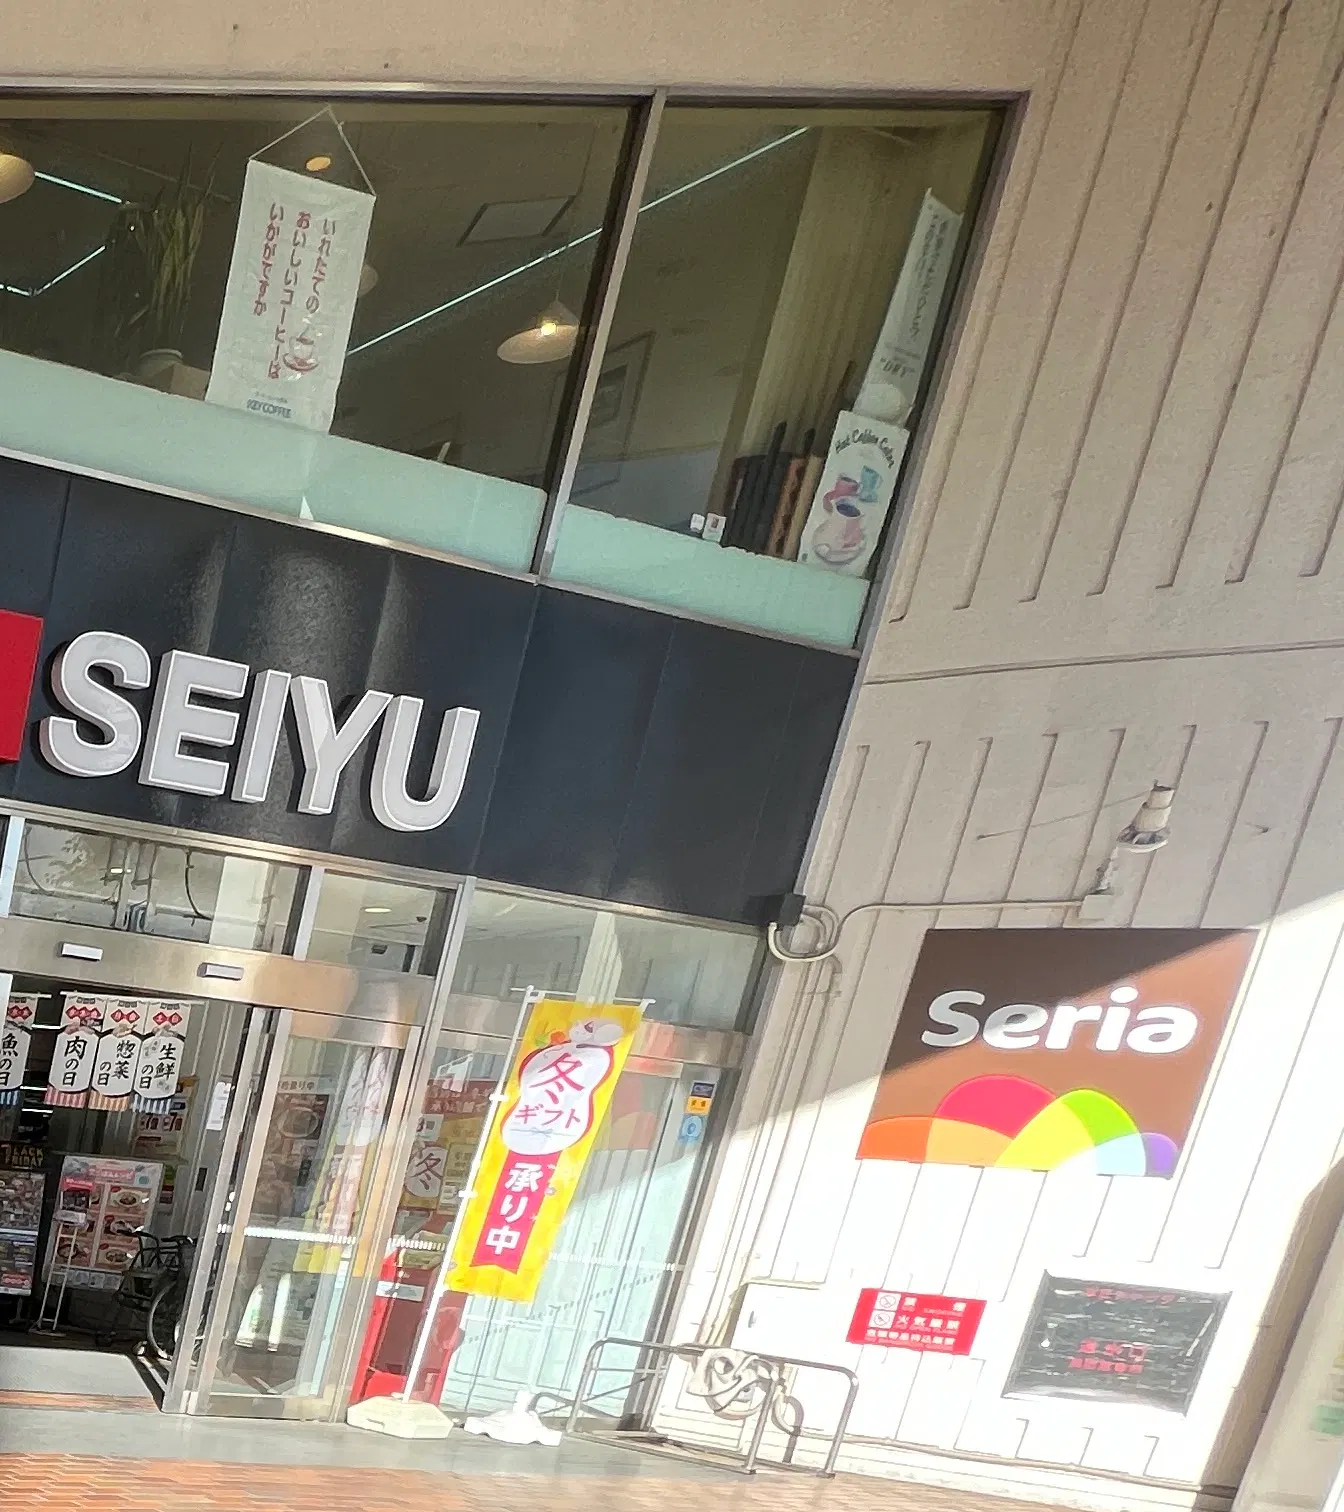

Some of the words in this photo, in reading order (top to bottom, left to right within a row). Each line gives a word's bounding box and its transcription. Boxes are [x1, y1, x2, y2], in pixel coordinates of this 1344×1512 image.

[253, 202, 284, 317] いかがですか
[306, 217, 336, 315] いれたての
[268, 210, 312, 380] おいしいコーヒーは
[39, 631, 481, 832] SEIYU
[921, 986, 1199, 1054] Seria
[62, 1036, 88, 1087] 肉の日
[97, 1061, 112, 1086] の日
[112, 1039, 136, 1080] 惣菜
[139, 1064, 154, 1090] の日
[155, 1043, 178, 1081] 生鮮
[530, 1052, 585, 1105] 冬
[515, 1104, 581, 1130] ギフト
[485, 1162, 544, 1256] 承り中
